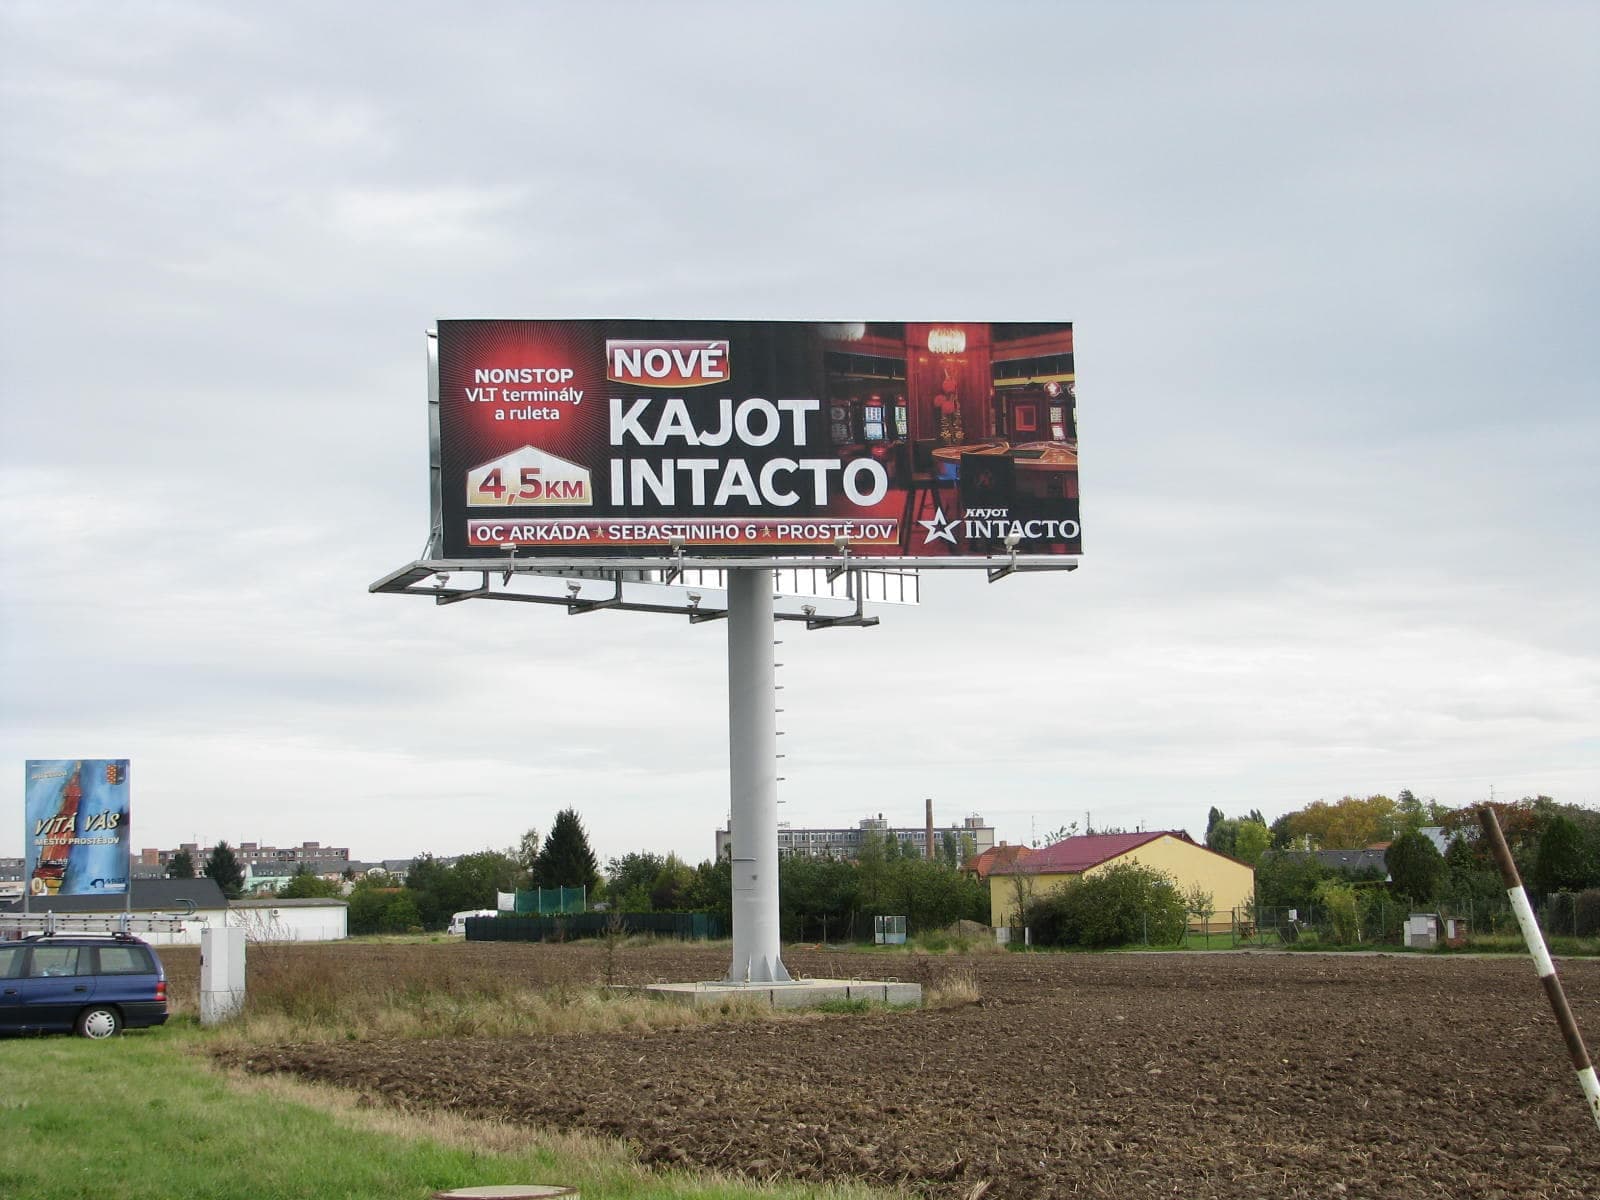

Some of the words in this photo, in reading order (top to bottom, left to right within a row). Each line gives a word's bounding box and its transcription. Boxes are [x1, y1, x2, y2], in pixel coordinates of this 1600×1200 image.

[614, 342, 724, 378] NOVÉ
[475, 369, 574, 383] NONSTOP
[465, 387, 499, 401] VLT
[502, 387, 584, 405] terminály
[495, 409, 505, 420] a
[509, 406, 560, 420] ruleta
[609, 398, 819, 446] KAJOT
[610, 458, 888, 507] INTACTO
[964, 508, 1009, 519] KAJOT
[476, 526, 504, 541] OC
[509, 522, 590, 540] ARKÁDA
[608, 525, 740, 540] SEBASTINIHO
[744, 525, 757, 539] 6
[777, 520, 893, 539] PROSTĚJOV
[965, 520, 1080, 539] INTACTO
